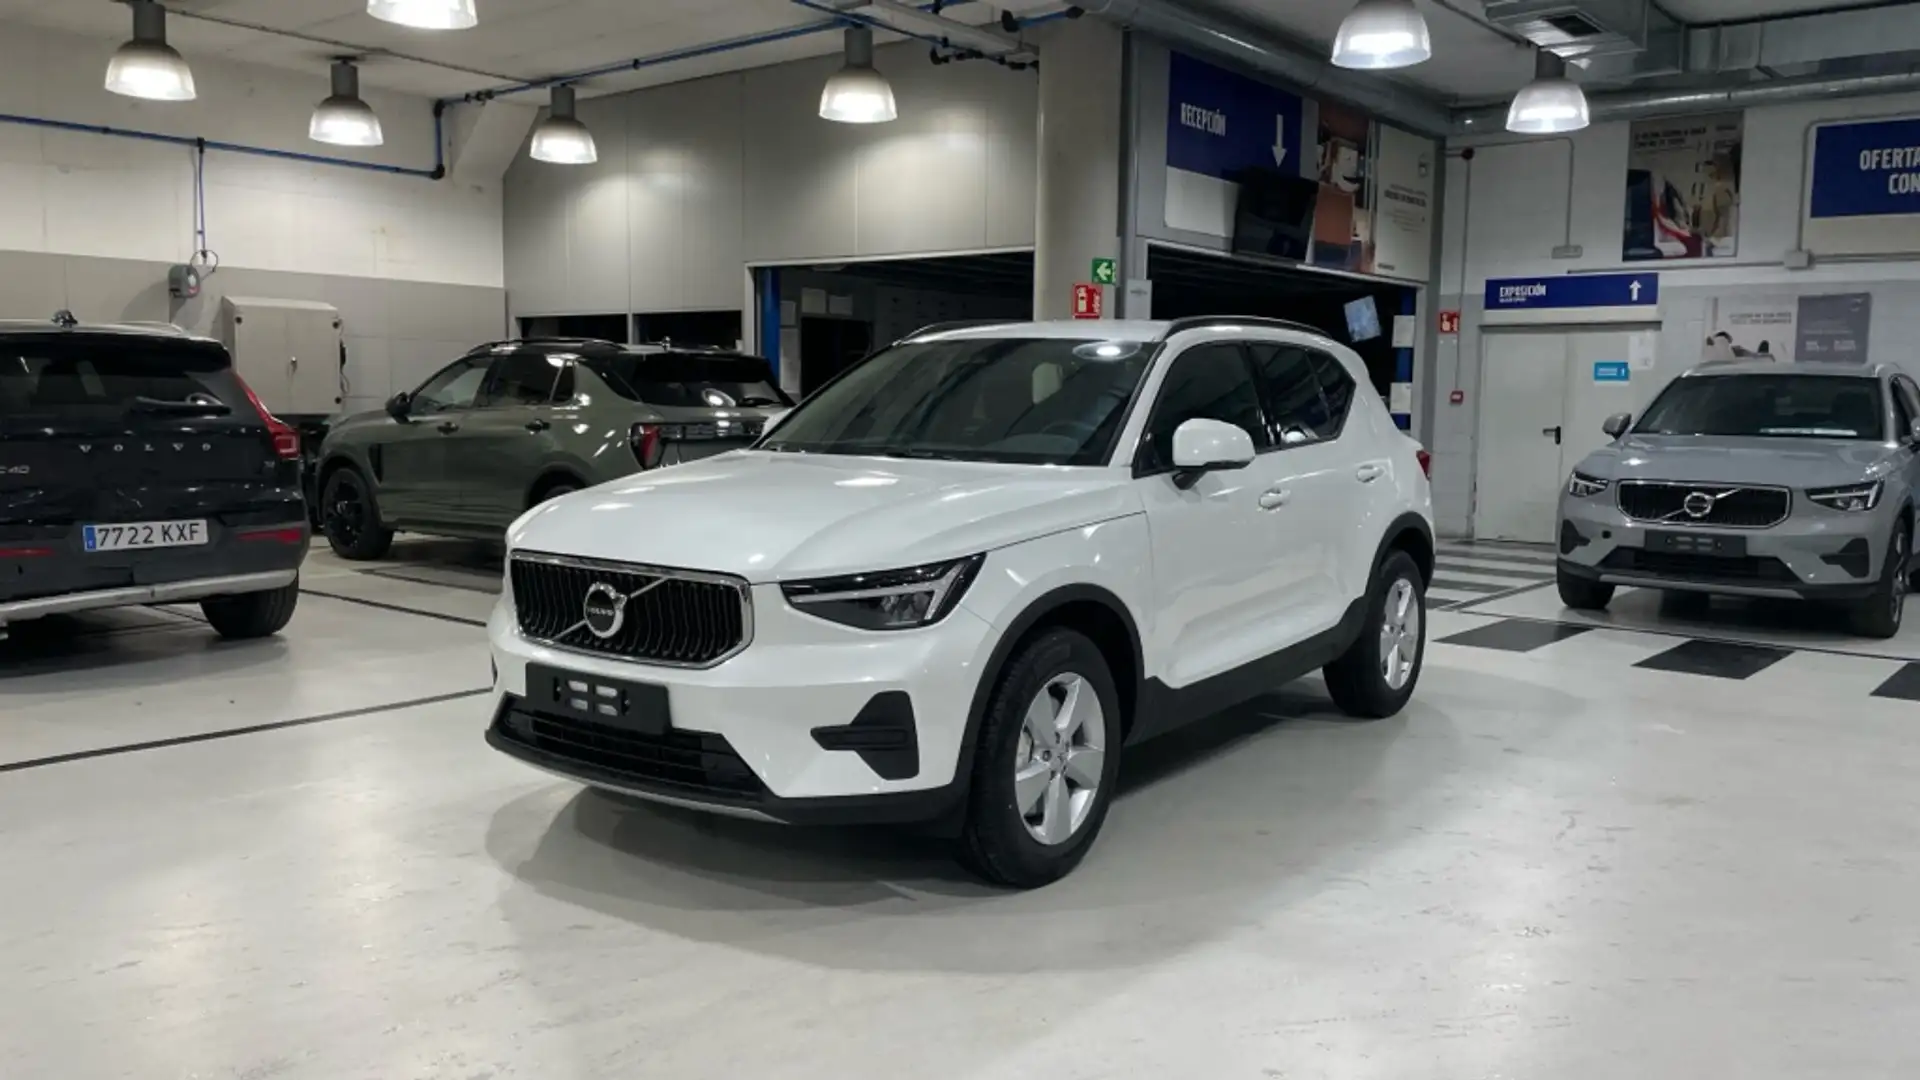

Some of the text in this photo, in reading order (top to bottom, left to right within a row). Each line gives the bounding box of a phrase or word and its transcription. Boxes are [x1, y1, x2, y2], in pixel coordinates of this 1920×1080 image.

[1500, 282, 1546, 298] EXPOSICIÓN
[79, 444, 212, 452] VOLVO
[98, 527, 154, 547] 7722
[161, 523, 200, 542] KXF
